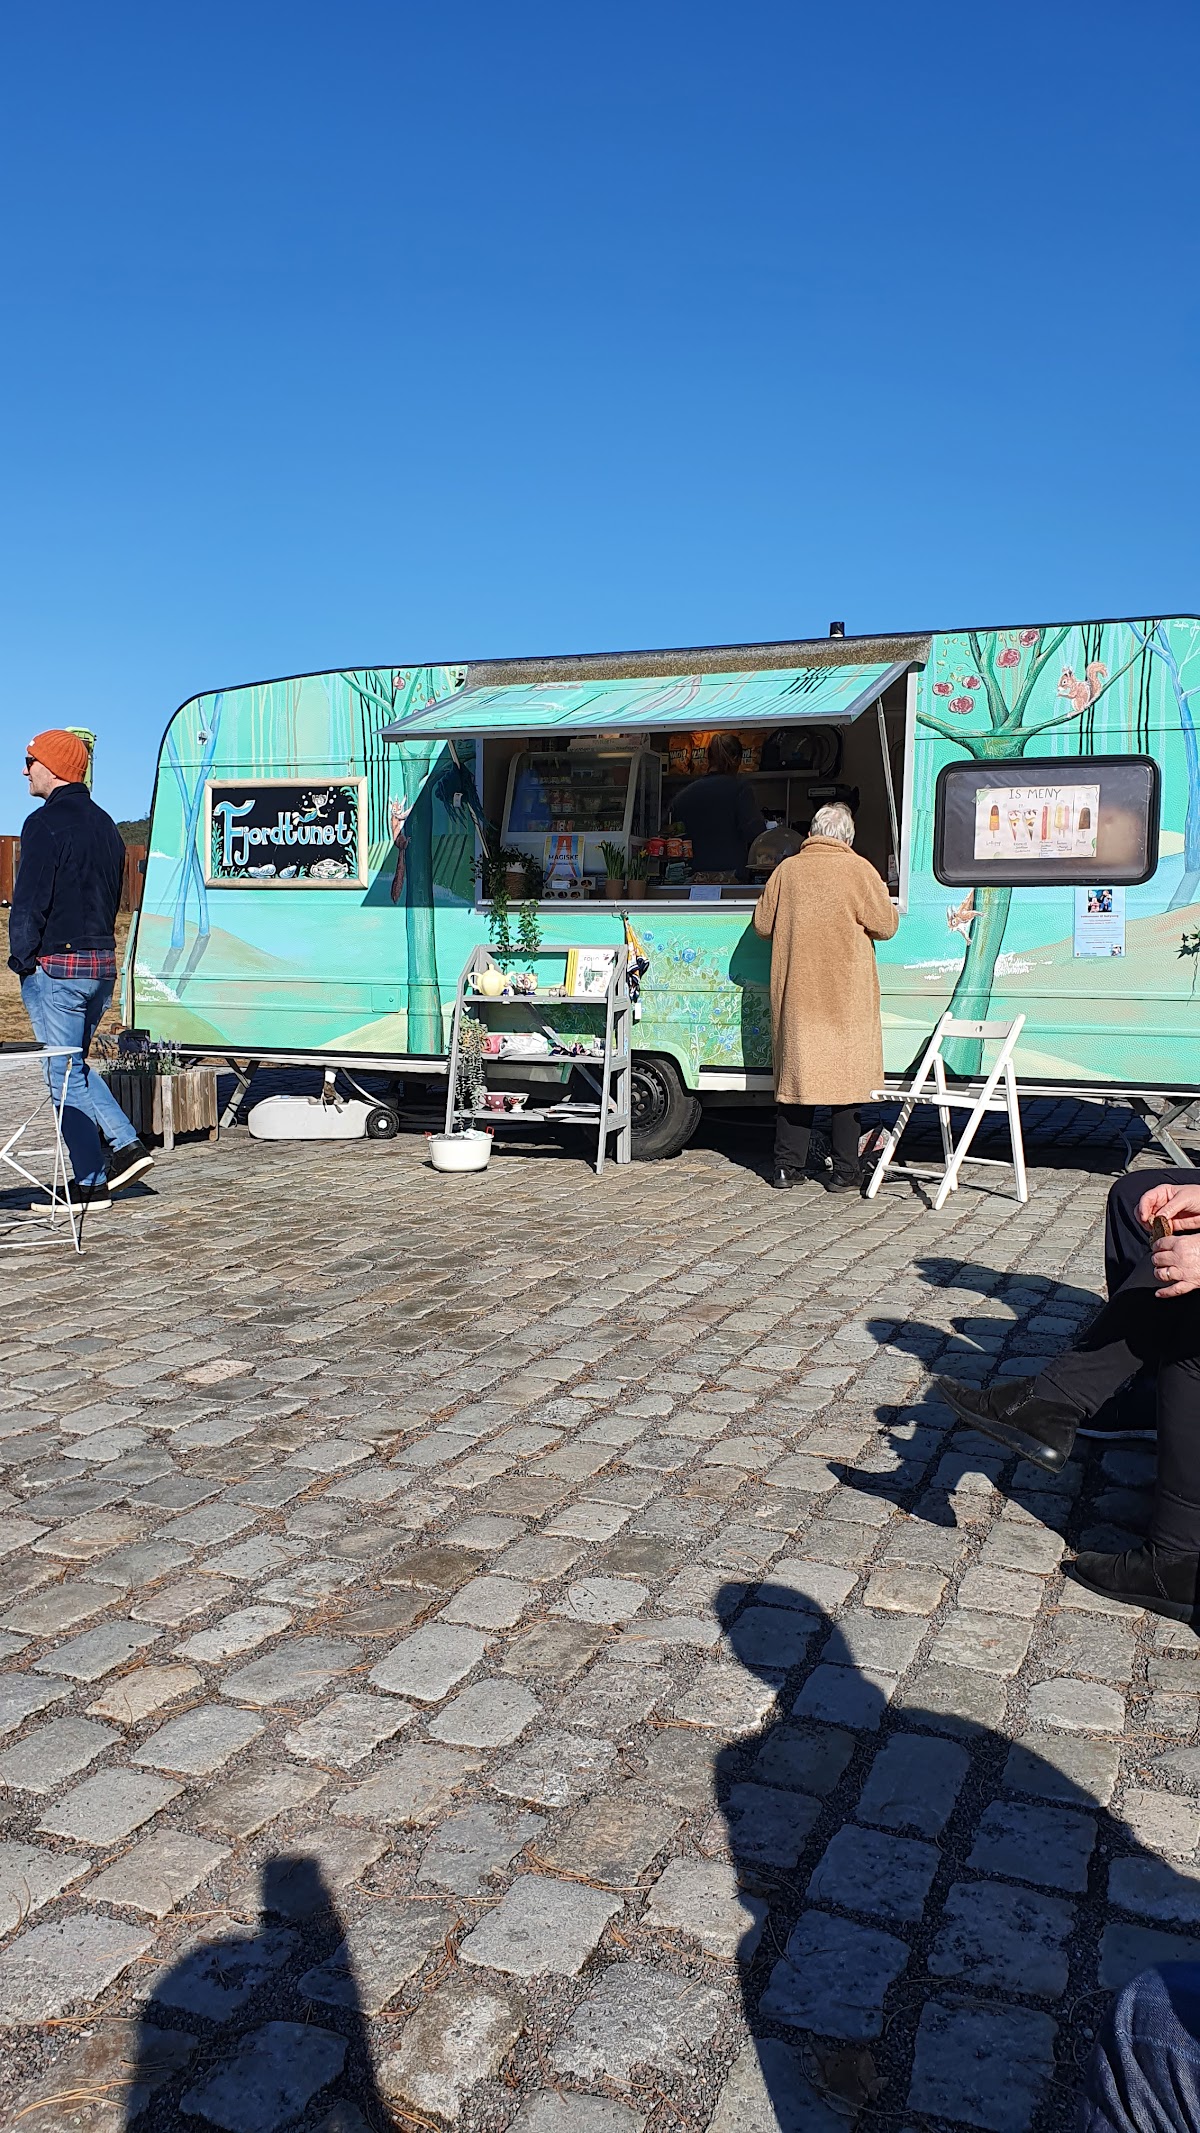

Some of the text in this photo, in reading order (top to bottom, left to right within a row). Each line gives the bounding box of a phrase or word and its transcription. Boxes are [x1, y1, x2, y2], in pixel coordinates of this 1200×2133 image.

[1009, 787, 1062, 801] IS MENY
[213, 799, 354, 867] Fjordtunet
